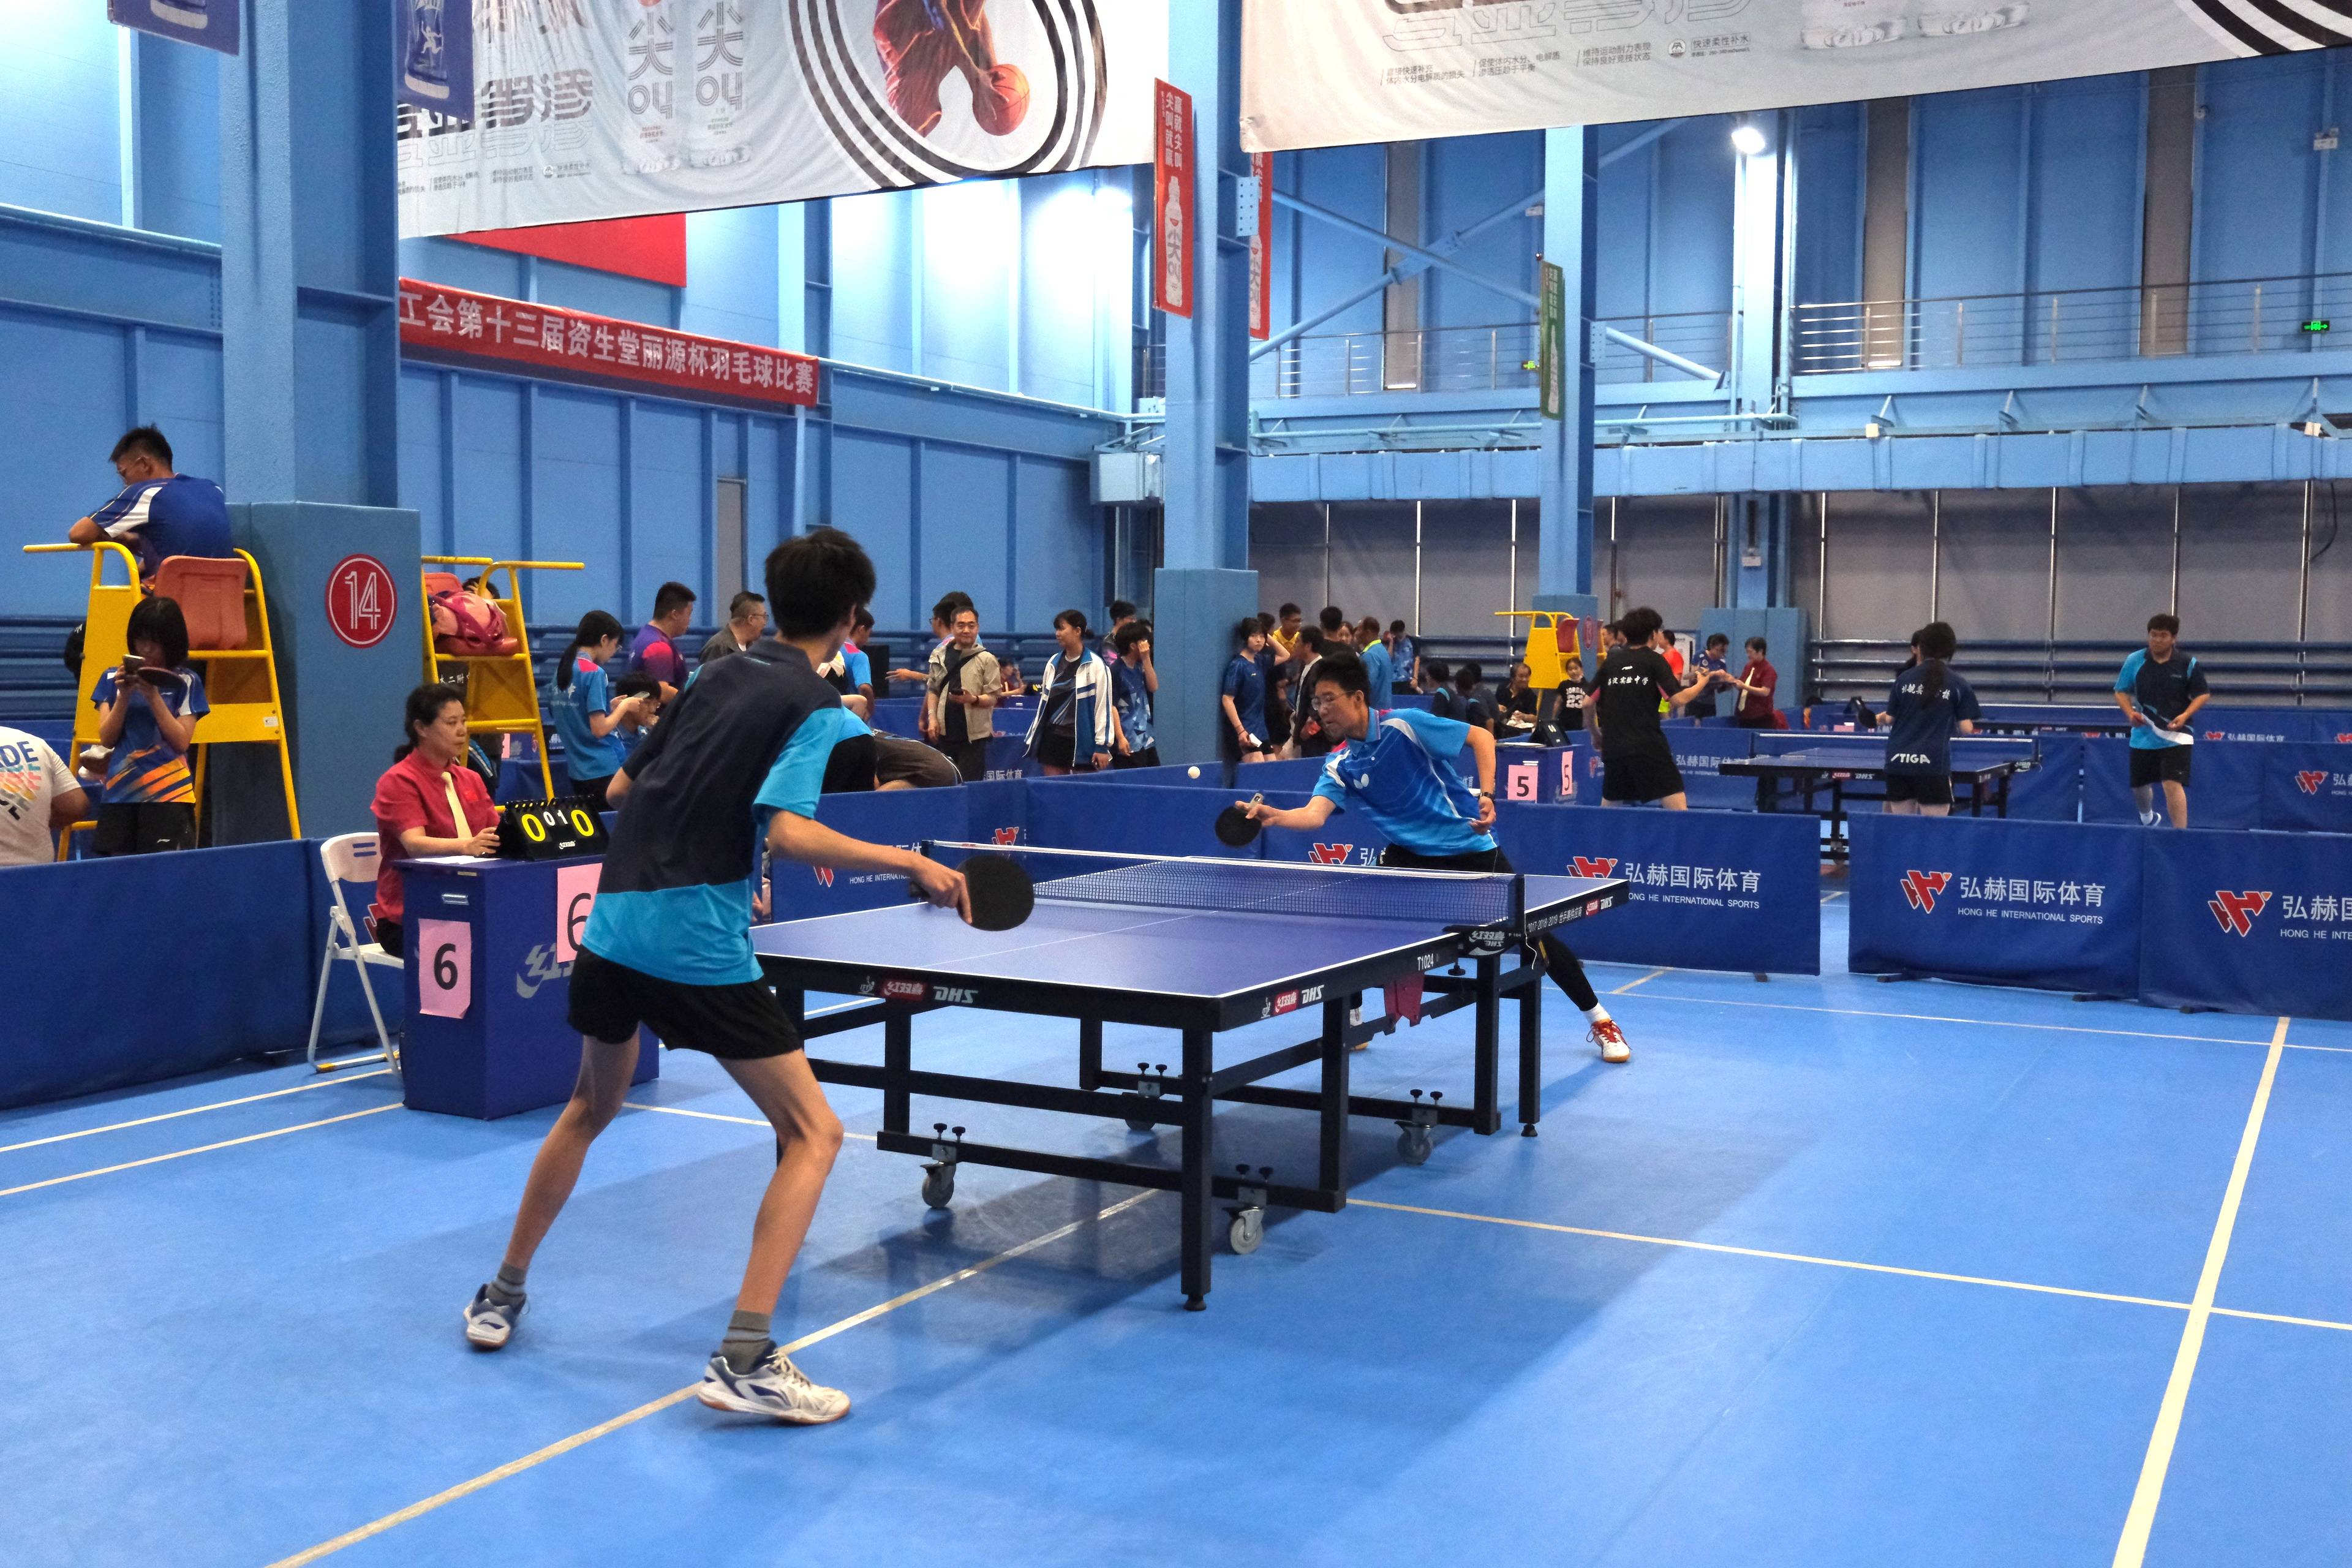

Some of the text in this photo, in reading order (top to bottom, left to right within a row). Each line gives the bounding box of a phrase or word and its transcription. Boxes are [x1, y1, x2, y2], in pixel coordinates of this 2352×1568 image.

[399, 291, 813, 395] 工会第十三届资生堂丽源杯羽毛球比赛
[344, 571, 381, 630] 14
[1566, 694, 1584, 709] 23
[0, 741, 39, 767] DE
[1891, 753, 1931, 764] STIGA
[984, 769, 1023, 780] 国际体育
[1564, 764, 1569, 791] 5
[1517, 775, 1529, 797] 5
[521, 809, 594, 842] 0 0 1 0
[850, 875, 865, 884] HONG
[1625, 862, 1761, 893] 弘赫国际体育
[1628, 892, 1760, 909] ONG HE INTERNATIONAL SPORTS
[1959, 876, 2106, 908] 弘赫国际体育
[1600, 896, 1613, 910] DHS
[1958, 907, 1982, 917] HONG
[2001, 910, 2065, 922] INTERNATIONAL
[2069, 914, 2103, 924] SPORTS
[2280, 929, 2309, 939] HONG
[2313, 930, 2327, 939] HE
[434, 942, 458, 990] 6
[1417, 953, 1434, 971] T1024
[933, 986, 979, 1004] DHS
[1301, 984, 1324, 1004] DHS
